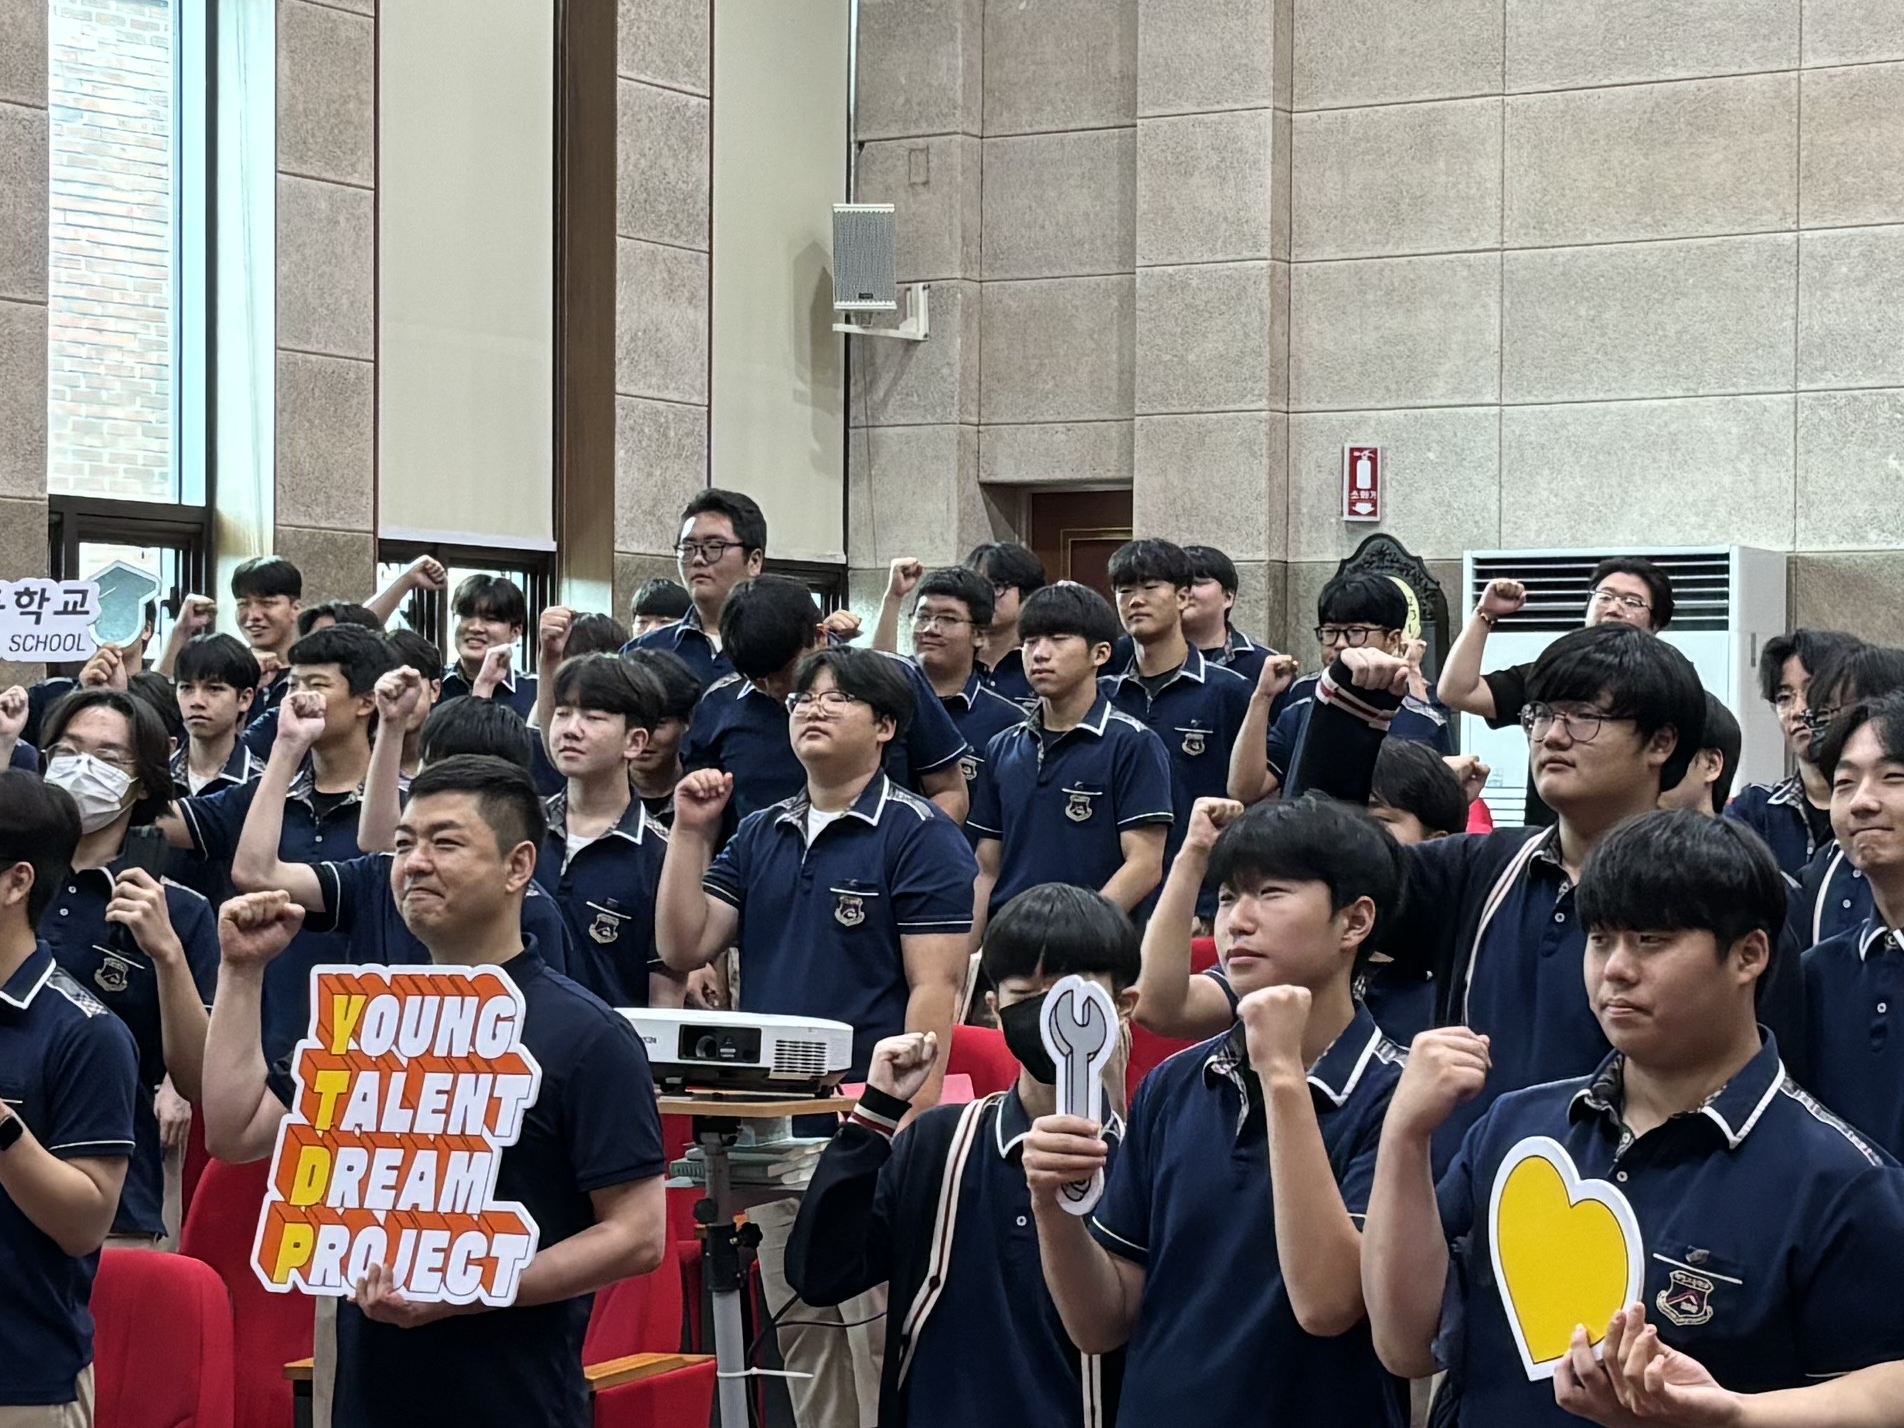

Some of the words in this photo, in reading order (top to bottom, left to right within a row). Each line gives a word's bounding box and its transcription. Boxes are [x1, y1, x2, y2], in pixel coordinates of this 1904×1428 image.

[8, 632, 87, 653] SCHOOL
[330, 993, 518, 1060] YOUNG
[313, 1069, 532, 1137] TALENT
[289, 1144, 492, 1214] DREAM
[272, 1221, 531, 1298] PROJECT
